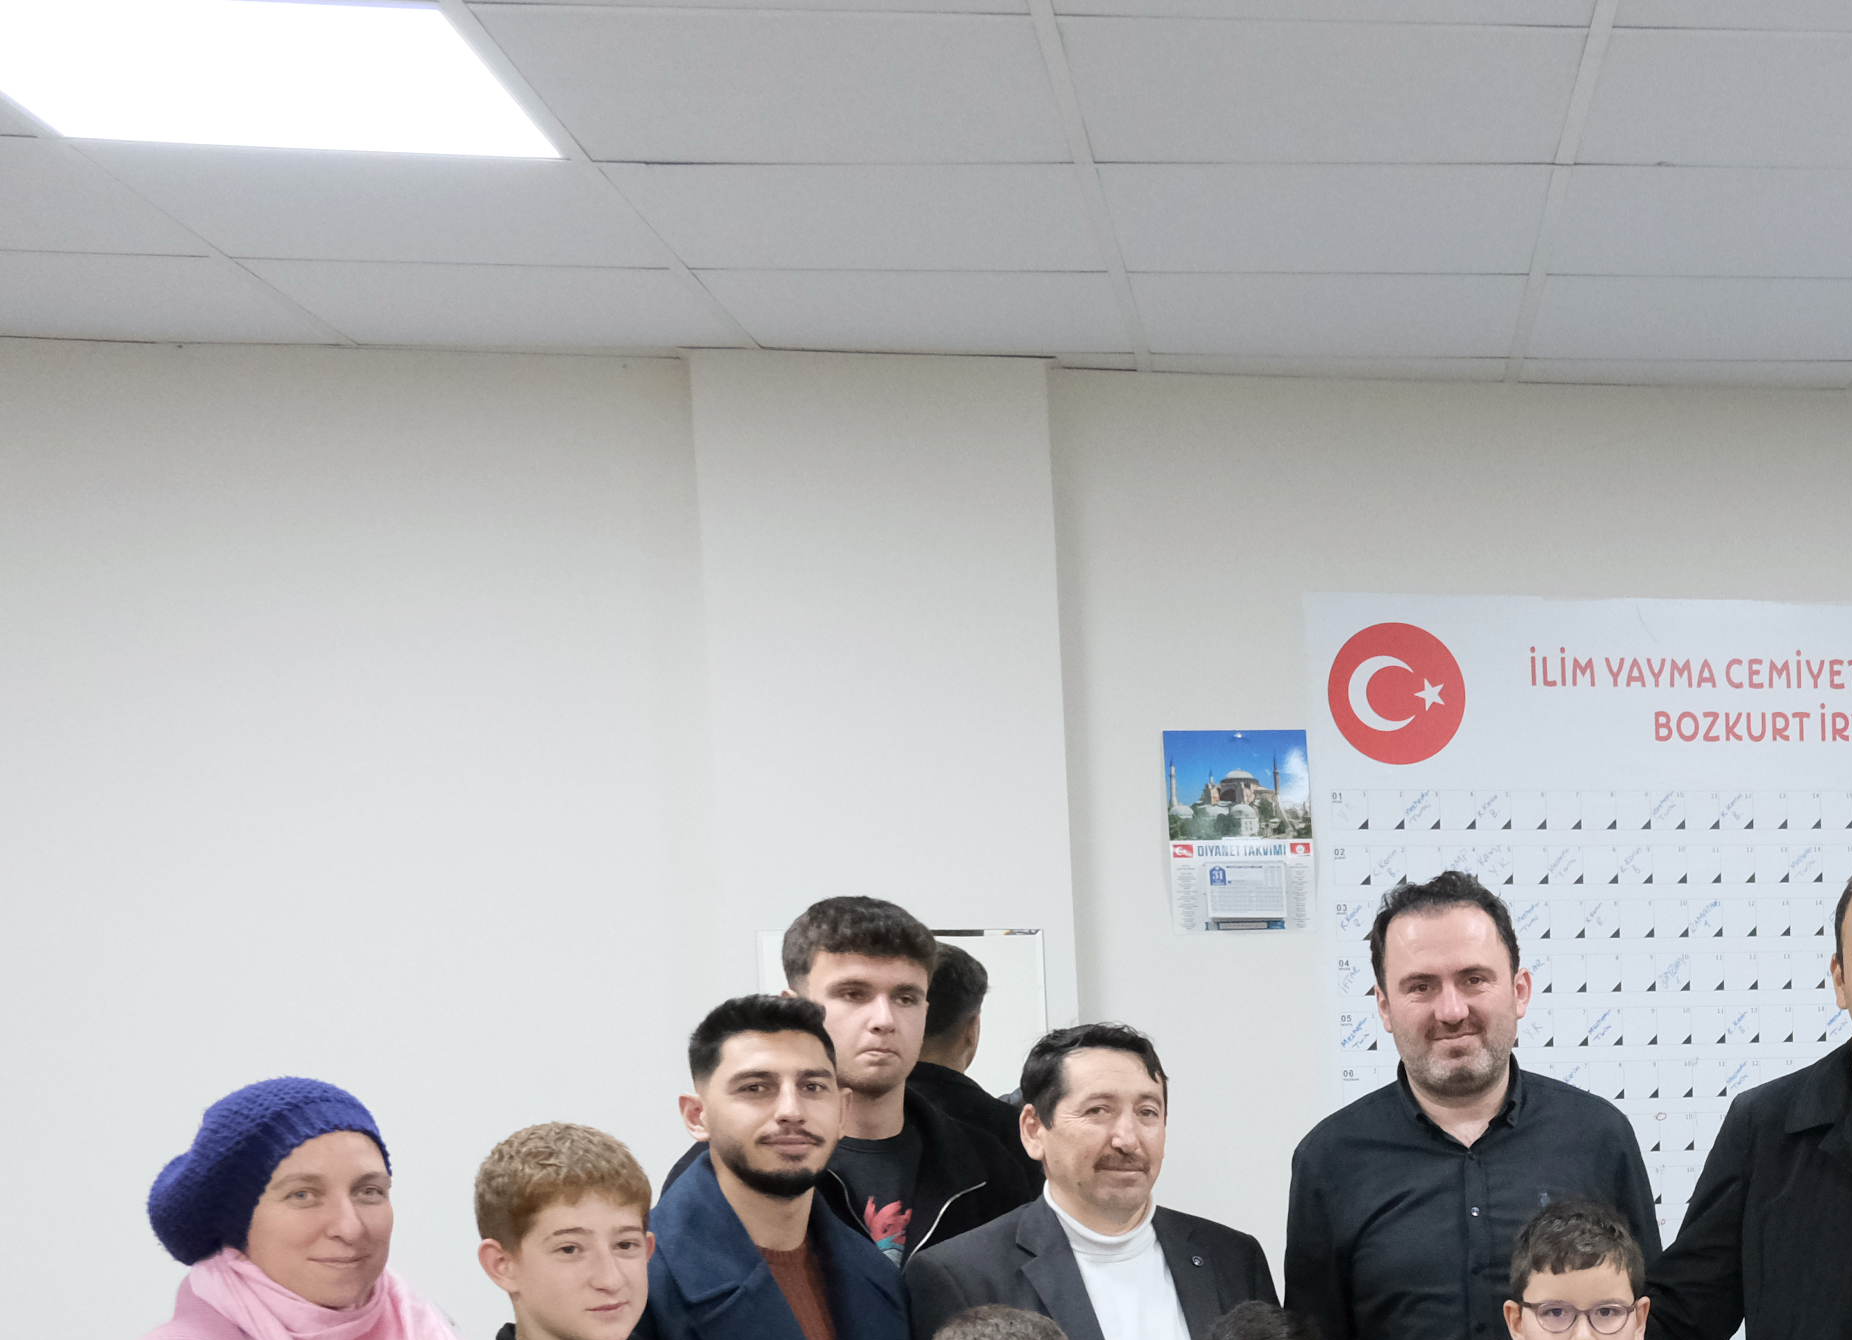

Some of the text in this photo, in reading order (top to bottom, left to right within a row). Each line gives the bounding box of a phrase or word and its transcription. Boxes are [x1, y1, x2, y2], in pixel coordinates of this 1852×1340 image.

[1530, 646, 1596, 687] İLİM
[1605, 657, 1717, 688] YAYMA
[1655, 710, 1811, 743] BOZKURT
